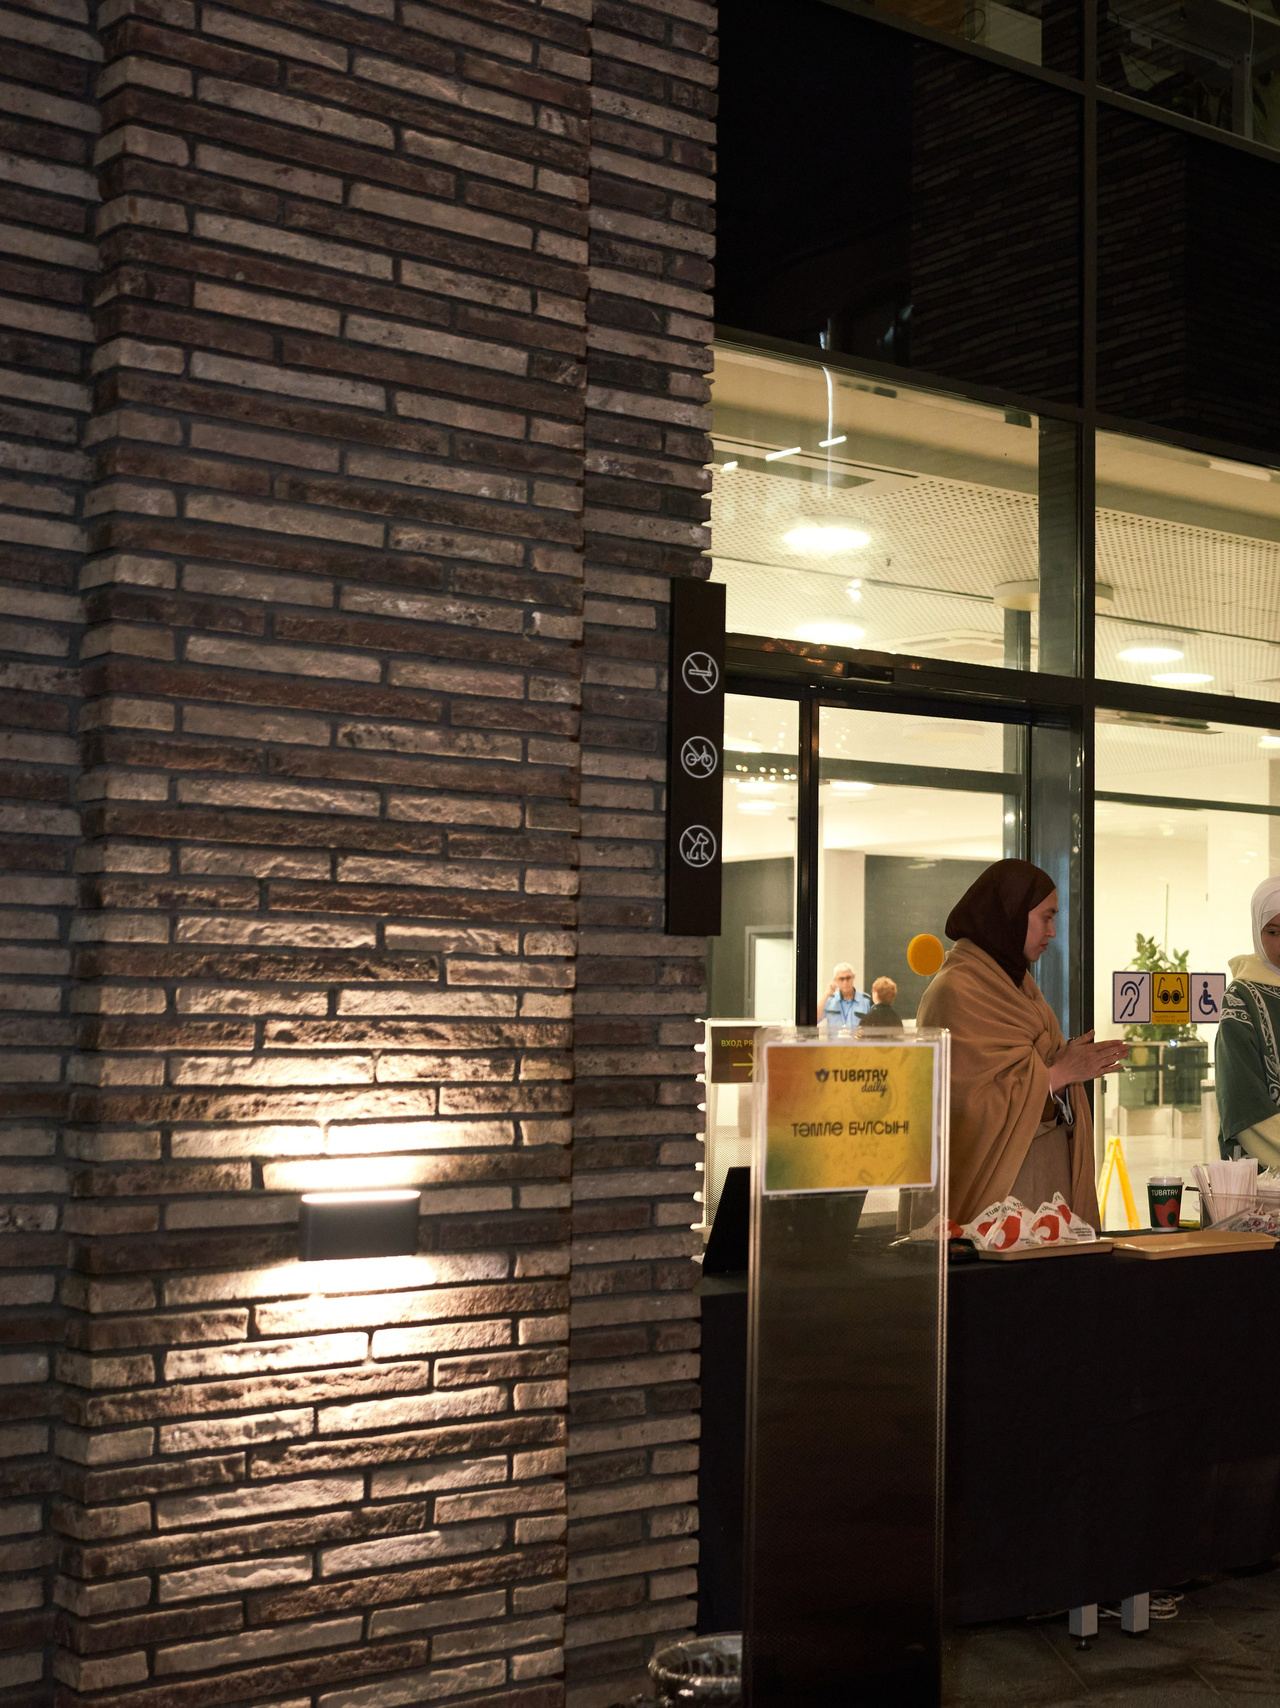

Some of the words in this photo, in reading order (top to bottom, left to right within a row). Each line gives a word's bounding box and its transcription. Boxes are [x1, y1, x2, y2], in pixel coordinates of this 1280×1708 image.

[721, 1039, 743, 1048] ВХОД
[833, 1069, 888, 1082] TUBATAY
[861, 1078, 887, 1098] daily
[1151, 1189, 1179, 1197] TUBATAY
